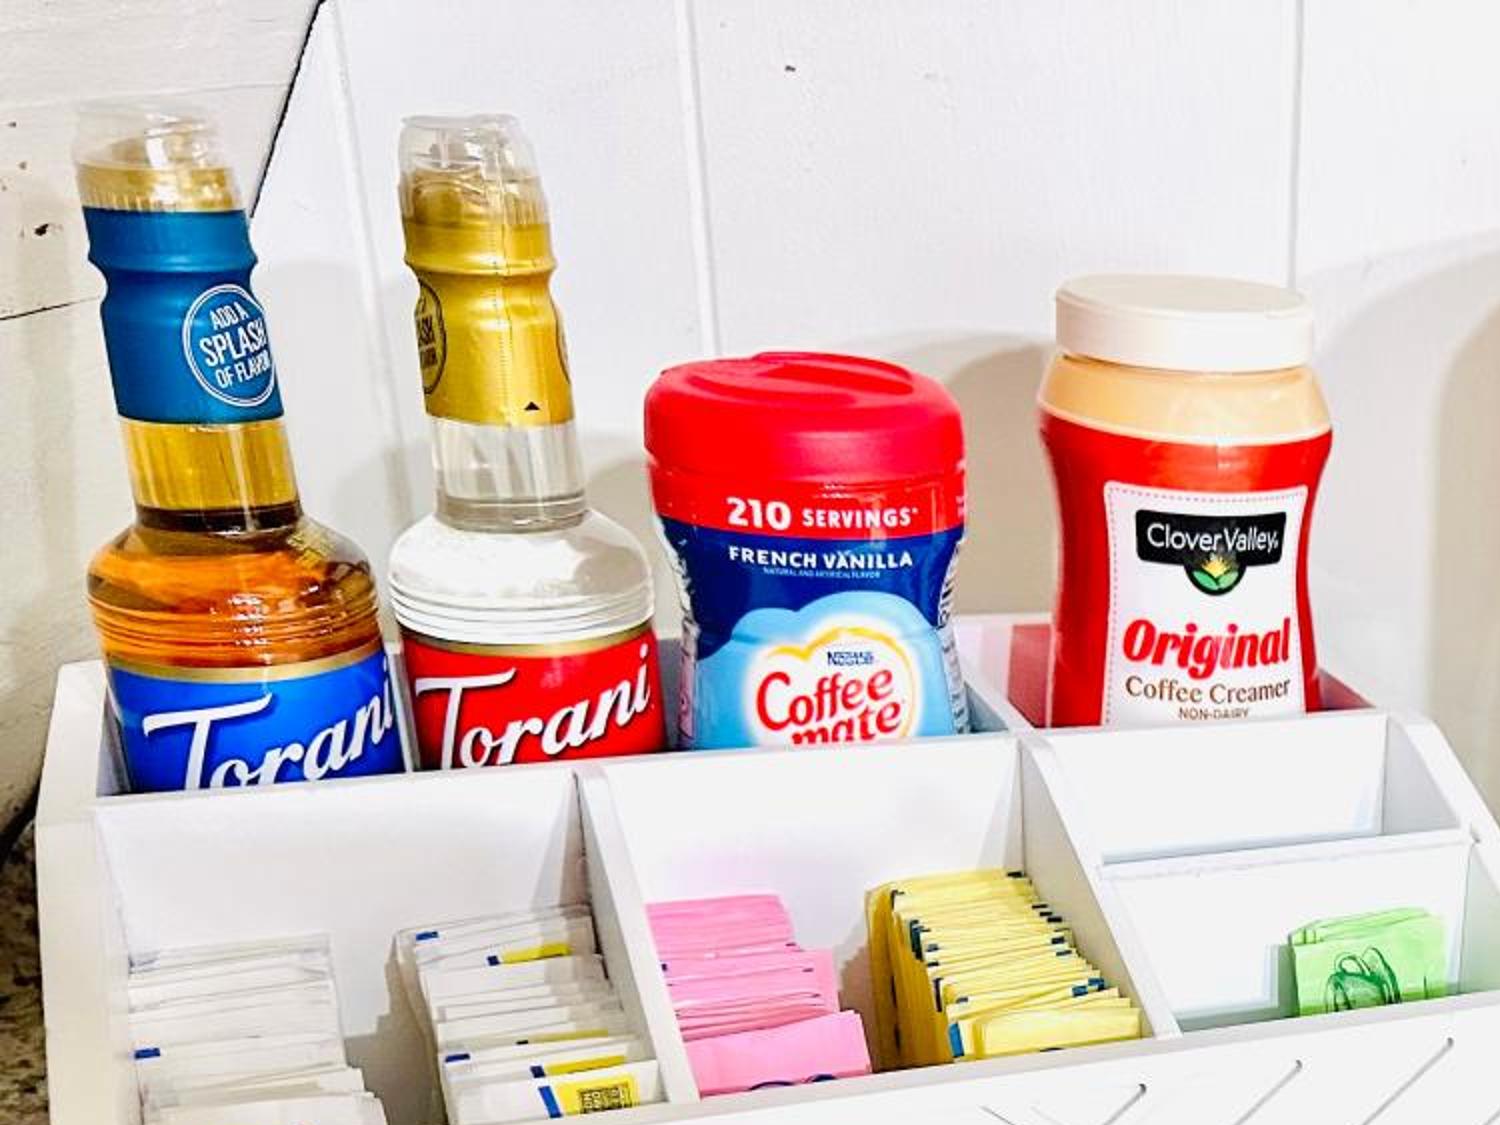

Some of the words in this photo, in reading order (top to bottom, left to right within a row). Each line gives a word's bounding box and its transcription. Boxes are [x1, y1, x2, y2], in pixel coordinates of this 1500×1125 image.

[210, 306, 238, 330] ADD
[234, 301, 249, 320] A
[199, 317, 268, 367] SPLASH
[215, 366, 233, 388] OF
[726, 497, 792, 531] 210
[1147, 522, 1221, 551] Clover
[728, 545, 817, 569] FRENCH
[822, 551, 913, 569] VANILLA
[1123, 617, 1291, 681] Original
[414, 643, 651, 769] Torani
[756, 669, 894, 731] Coffee
[1125, 674, 1203, 703] Coffee
[1209, 677, 1291, 704] Creamer
[142, 657, 395, 791] Torani
[791, 702, 902, 744] mate
[1177, 706, 1249, 721] NON-DAIRY
